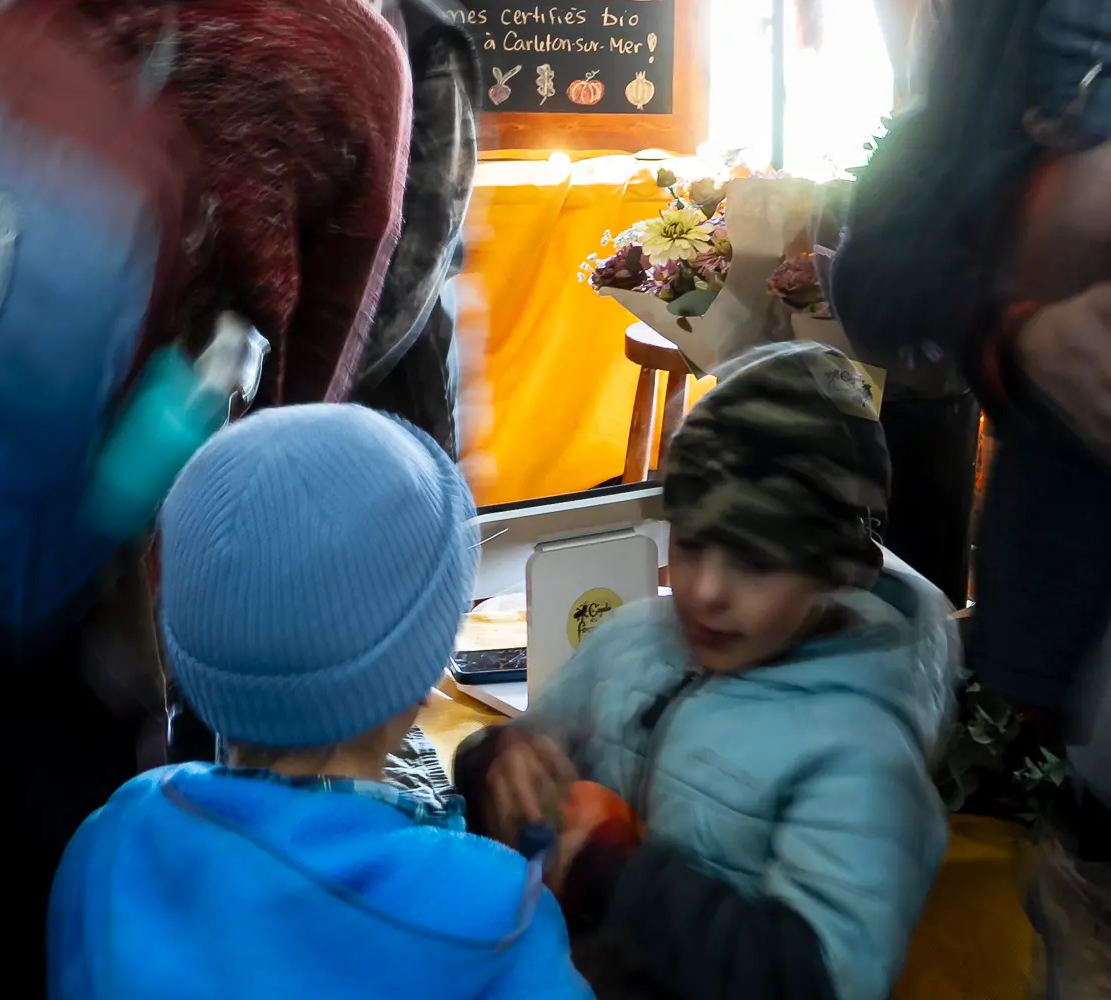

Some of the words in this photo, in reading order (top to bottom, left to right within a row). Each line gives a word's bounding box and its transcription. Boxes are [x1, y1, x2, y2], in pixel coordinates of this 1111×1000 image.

[500, 6, 587, 26] certifiés
[601, 6, 639, 27] bio
[484, 32, 496, 50] à
